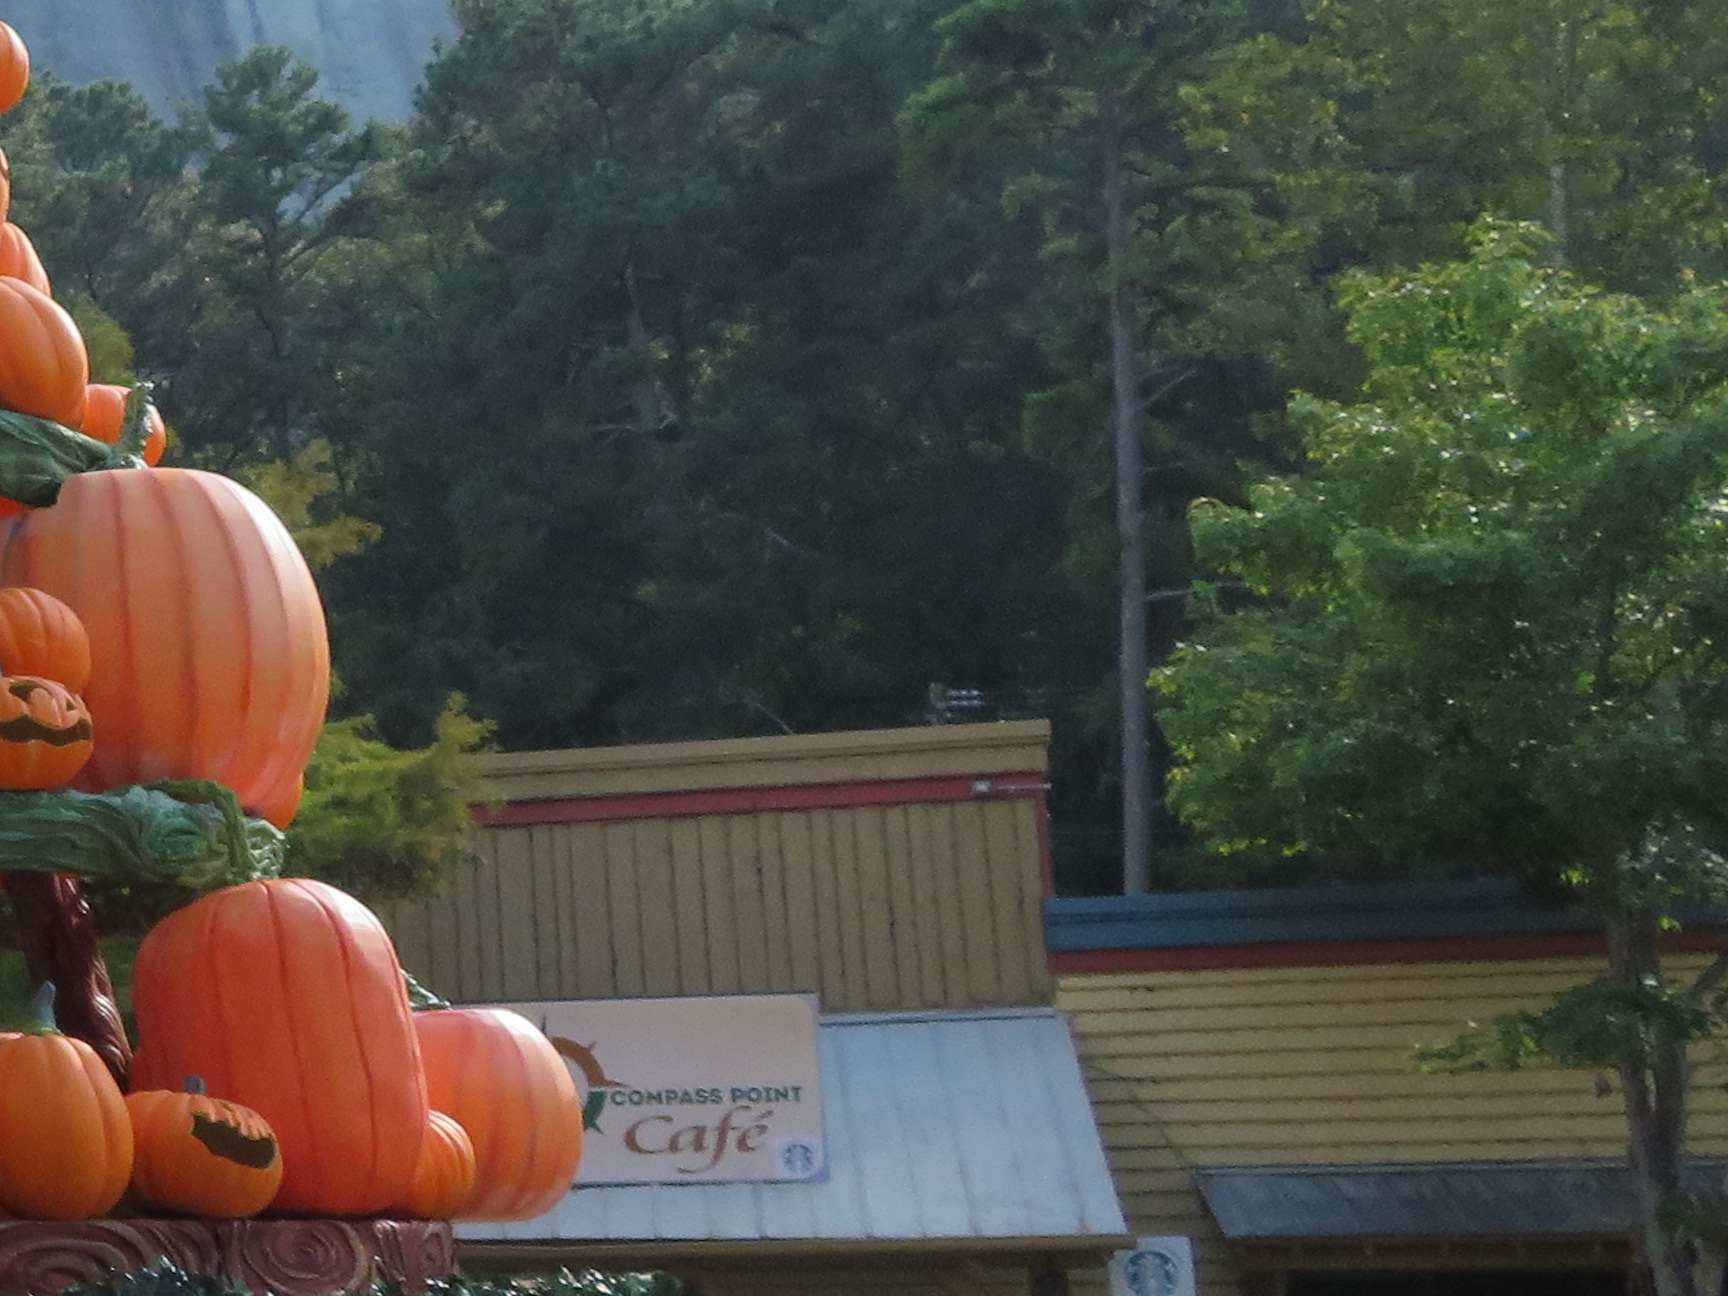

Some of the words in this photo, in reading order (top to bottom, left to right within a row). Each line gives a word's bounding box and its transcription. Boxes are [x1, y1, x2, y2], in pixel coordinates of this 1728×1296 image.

[609, 1088, 724, 1106] COMPASS
[729, 1086, 803, 1103] POINT
[624, 1104, 775, 1174] Café
